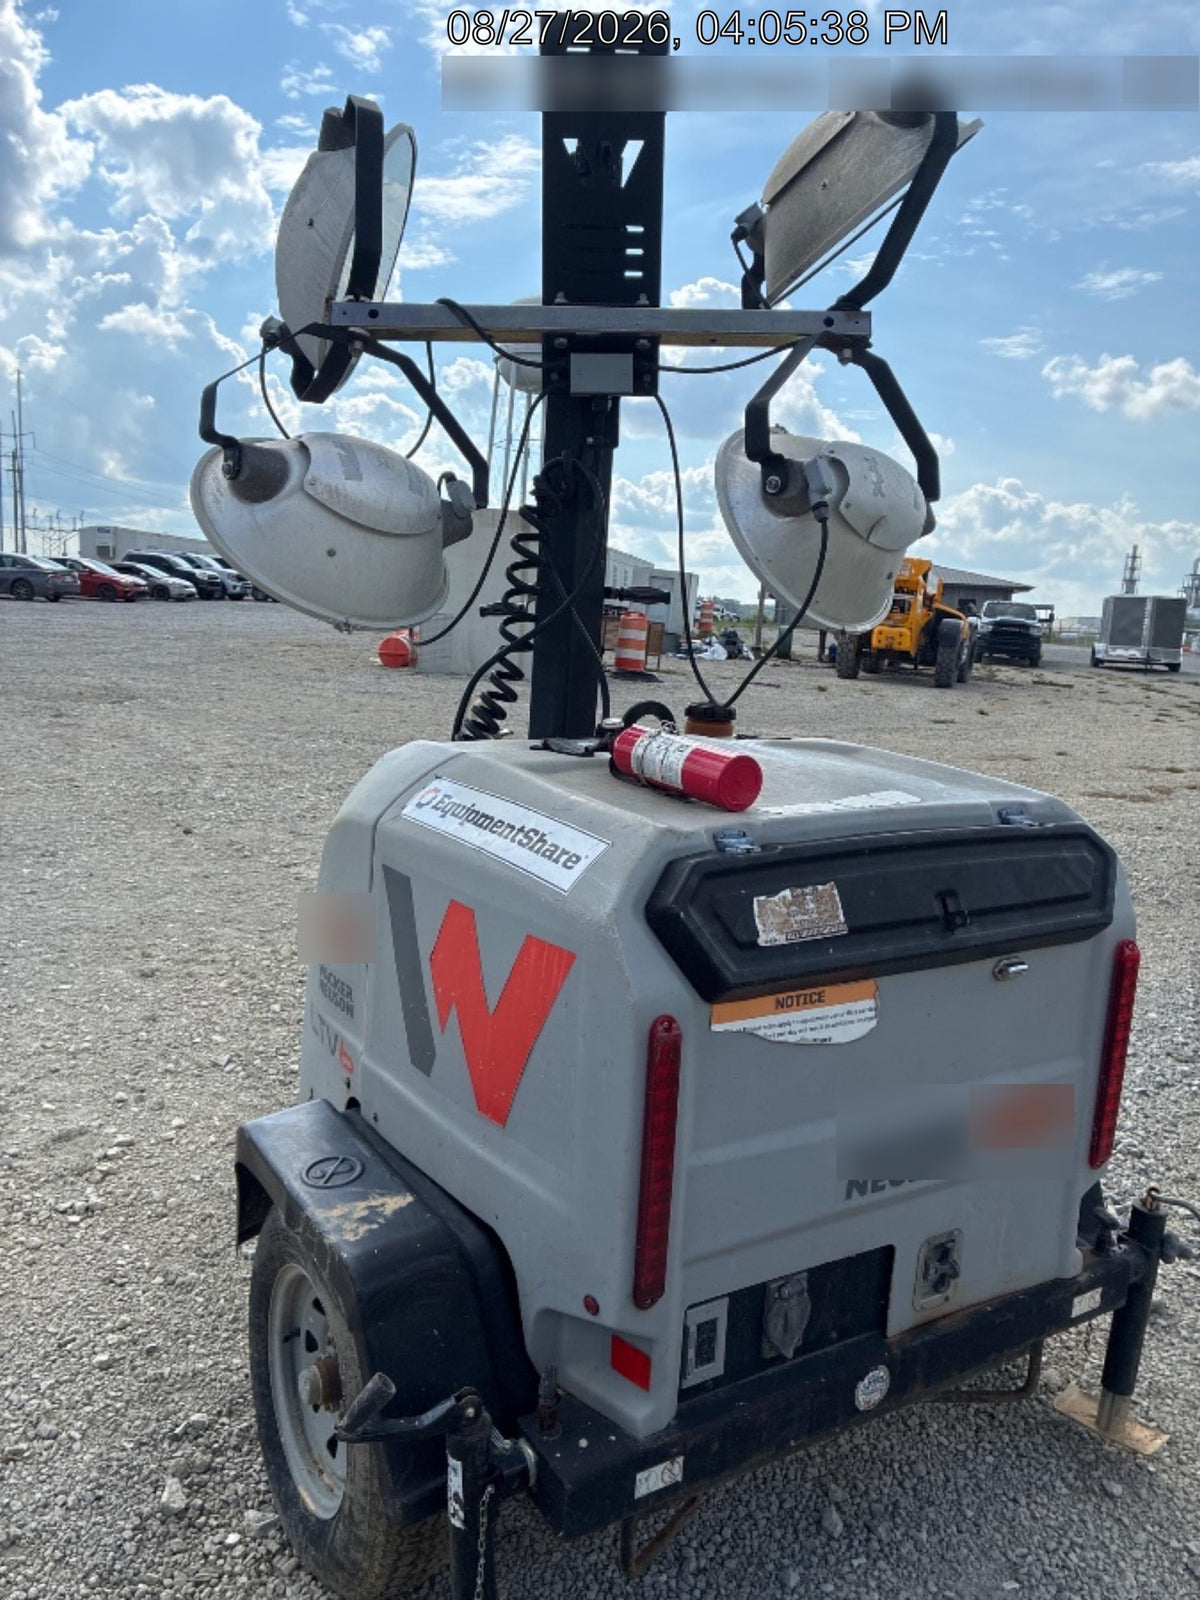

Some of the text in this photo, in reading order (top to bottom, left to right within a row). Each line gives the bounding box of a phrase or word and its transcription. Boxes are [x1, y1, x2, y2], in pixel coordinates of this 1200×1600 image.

[431, 793, 582, 870] EquipmentShare
[319, 979, 355, 1019] NEUSON
[775, 990, 826, 1010] NOTICE
